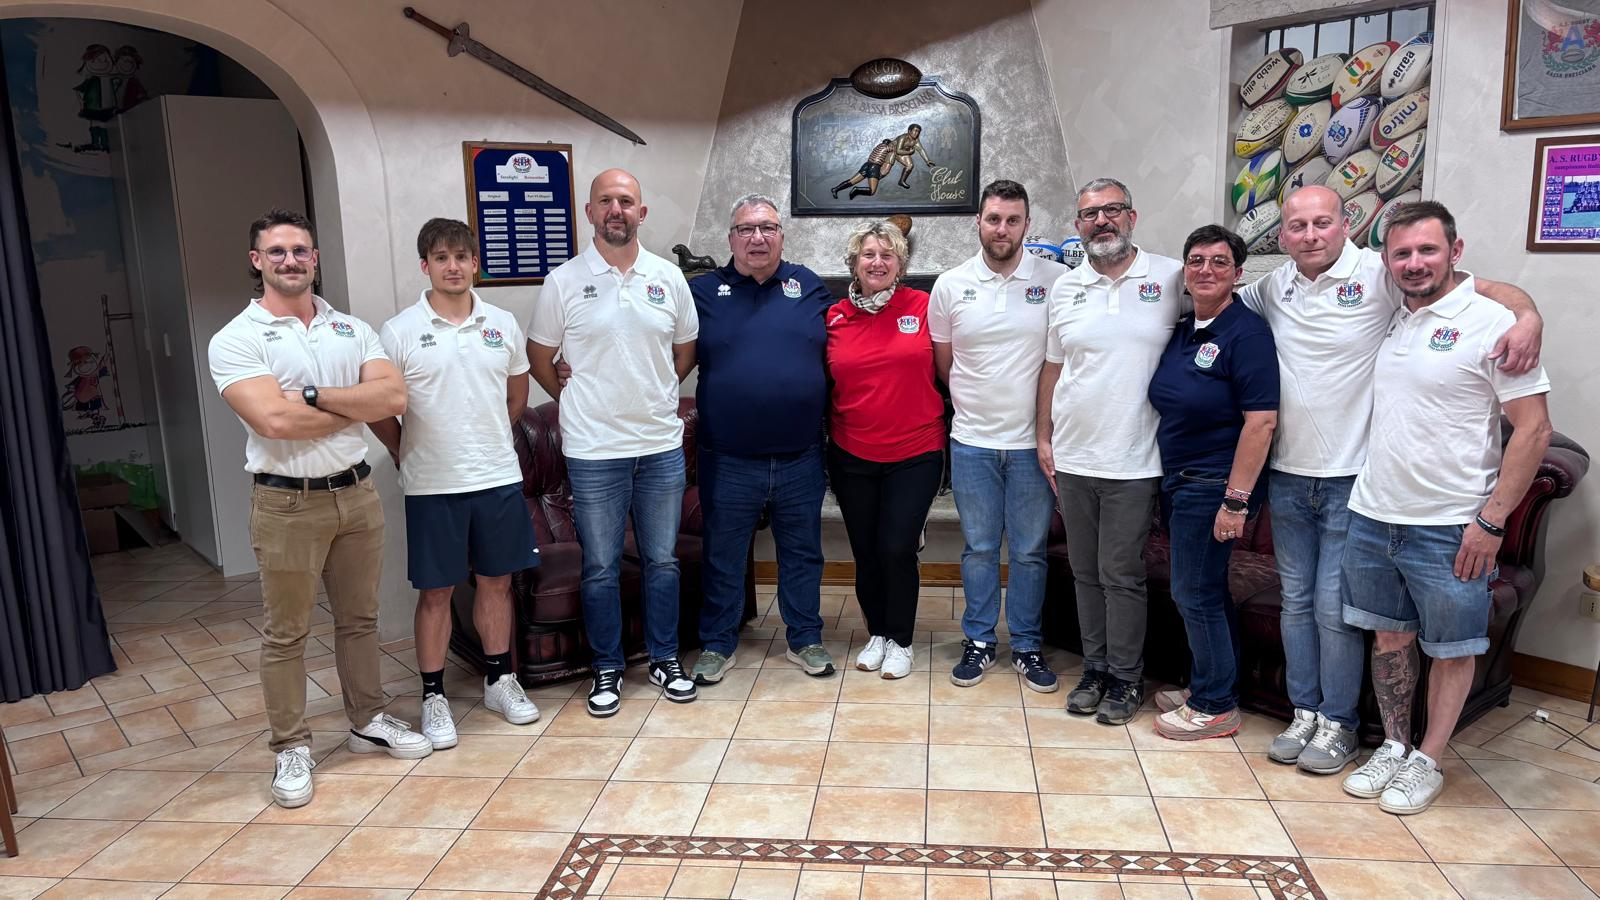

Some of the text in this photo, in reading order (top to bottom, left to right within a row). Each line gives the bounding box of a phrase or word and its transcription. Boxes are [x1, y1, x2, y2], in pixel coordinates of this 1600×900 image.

[1256, 57, 1280, 80] webb
[1242, 80, 1257, 97] ellis
[888, 89, 935, 117] BRESCIANA
[1382, 101, 1418, 134] mitre
[930, 166, 963, 185] Club
[930, 184, 966, 202] House
[1065, 249, 1085, 258] ILBE
